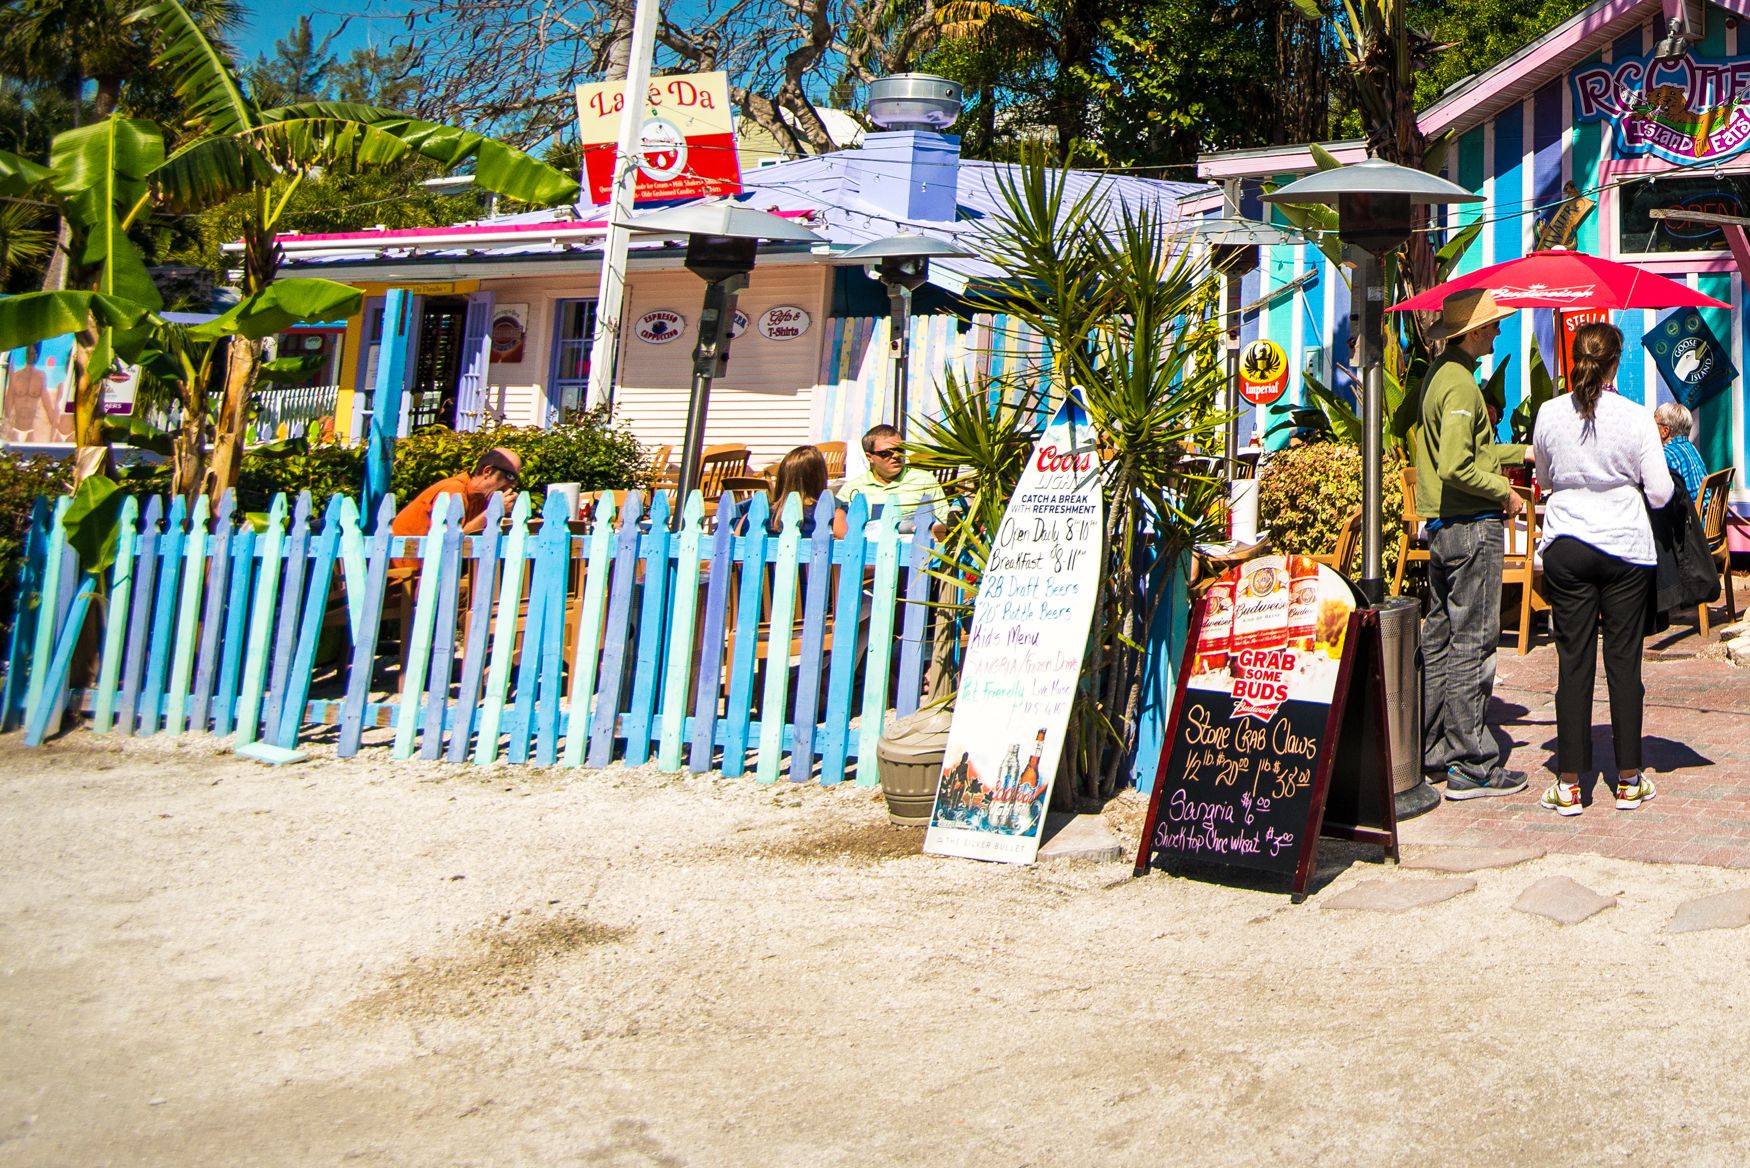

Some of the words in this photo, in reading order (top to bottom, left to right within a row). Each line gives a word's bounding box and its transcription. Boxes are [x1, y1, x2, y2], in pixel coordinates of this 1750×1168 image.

[668, 80, 715, 111] Da
[643, 312, 678, 323] ESPRESSO
[767, 310, 793, 326] Gifts
[792, 311, 801, 321] &
[1566, 313, 1606, 332] STELLA
[640, 329, 678, 341] CAPPUCCINO
[768, 327, 800, 338] T-Shirts
[1674, 339, 1698, 358] GOOSE
[1690, 358, 1712, 382] ISLAND
[1244, 380, 1279, 401] Imperial
[1036, 445, 1092, 473] Coors
[1021, 494, 1051, 504] CATCH
[1050, 494, 1057, 504] A
[1058, 494, 1088, 504] BREAK
[1011, 504, 1031, 514] WITH
[1032, 505, 1096, 515] REFRESHMENT
[1000, 517, 1031, 548] Open
[1032, 517, 1060, 545] Daily
[1007, 575, 1040, 599] Draft
[1045, 576, 1080, 598] Beers
[1039, 600, 1073, 622] Beers
[970, 624, 1001, 649] Kids
[1007, 624, 1040, 649] Menu
[1239, 649, 1296, 671] GRAB
[1246, 668, 1283, 682] SOME
[1232, 681, 1288, 701] BUDS
[1234, 700, 1278, 715] Budweiser
[1185, 704, 1231, 751] Stone
[1235, 716, 1267, 753] CRAB
[1272, 717, 1317, 760] Claws
[1168, 788, 1235, 829] Sangria
[945, 835, 961, 847] THE
[963, 838, 992, 850] SILVER
[993, 841, 1025, 853] BULLET
[1230, 828, 1261, 855] wheat
